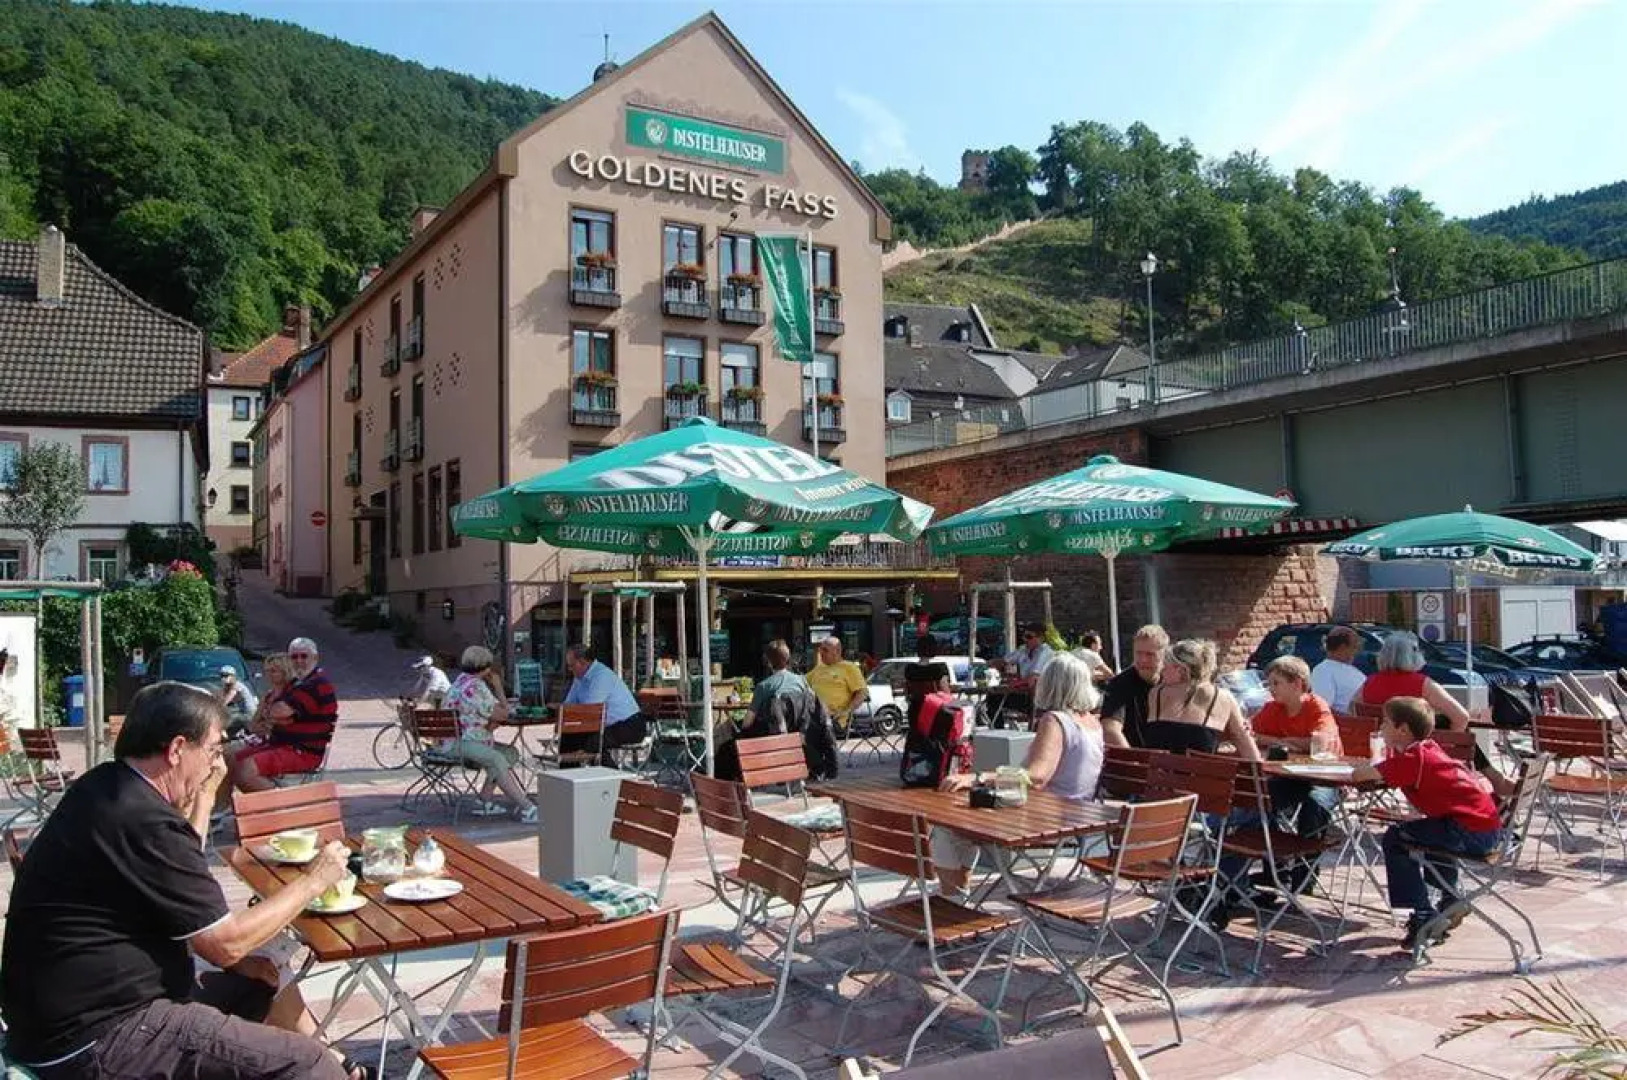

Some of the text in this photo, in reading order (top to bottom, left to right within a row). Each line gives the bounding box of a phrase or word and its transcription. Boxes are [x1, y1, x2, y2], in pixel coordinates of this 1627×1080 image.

[673, 127, 767, 162] DISTELHAUSER
[568, 150, 839, 220] GOLDENES FASS
